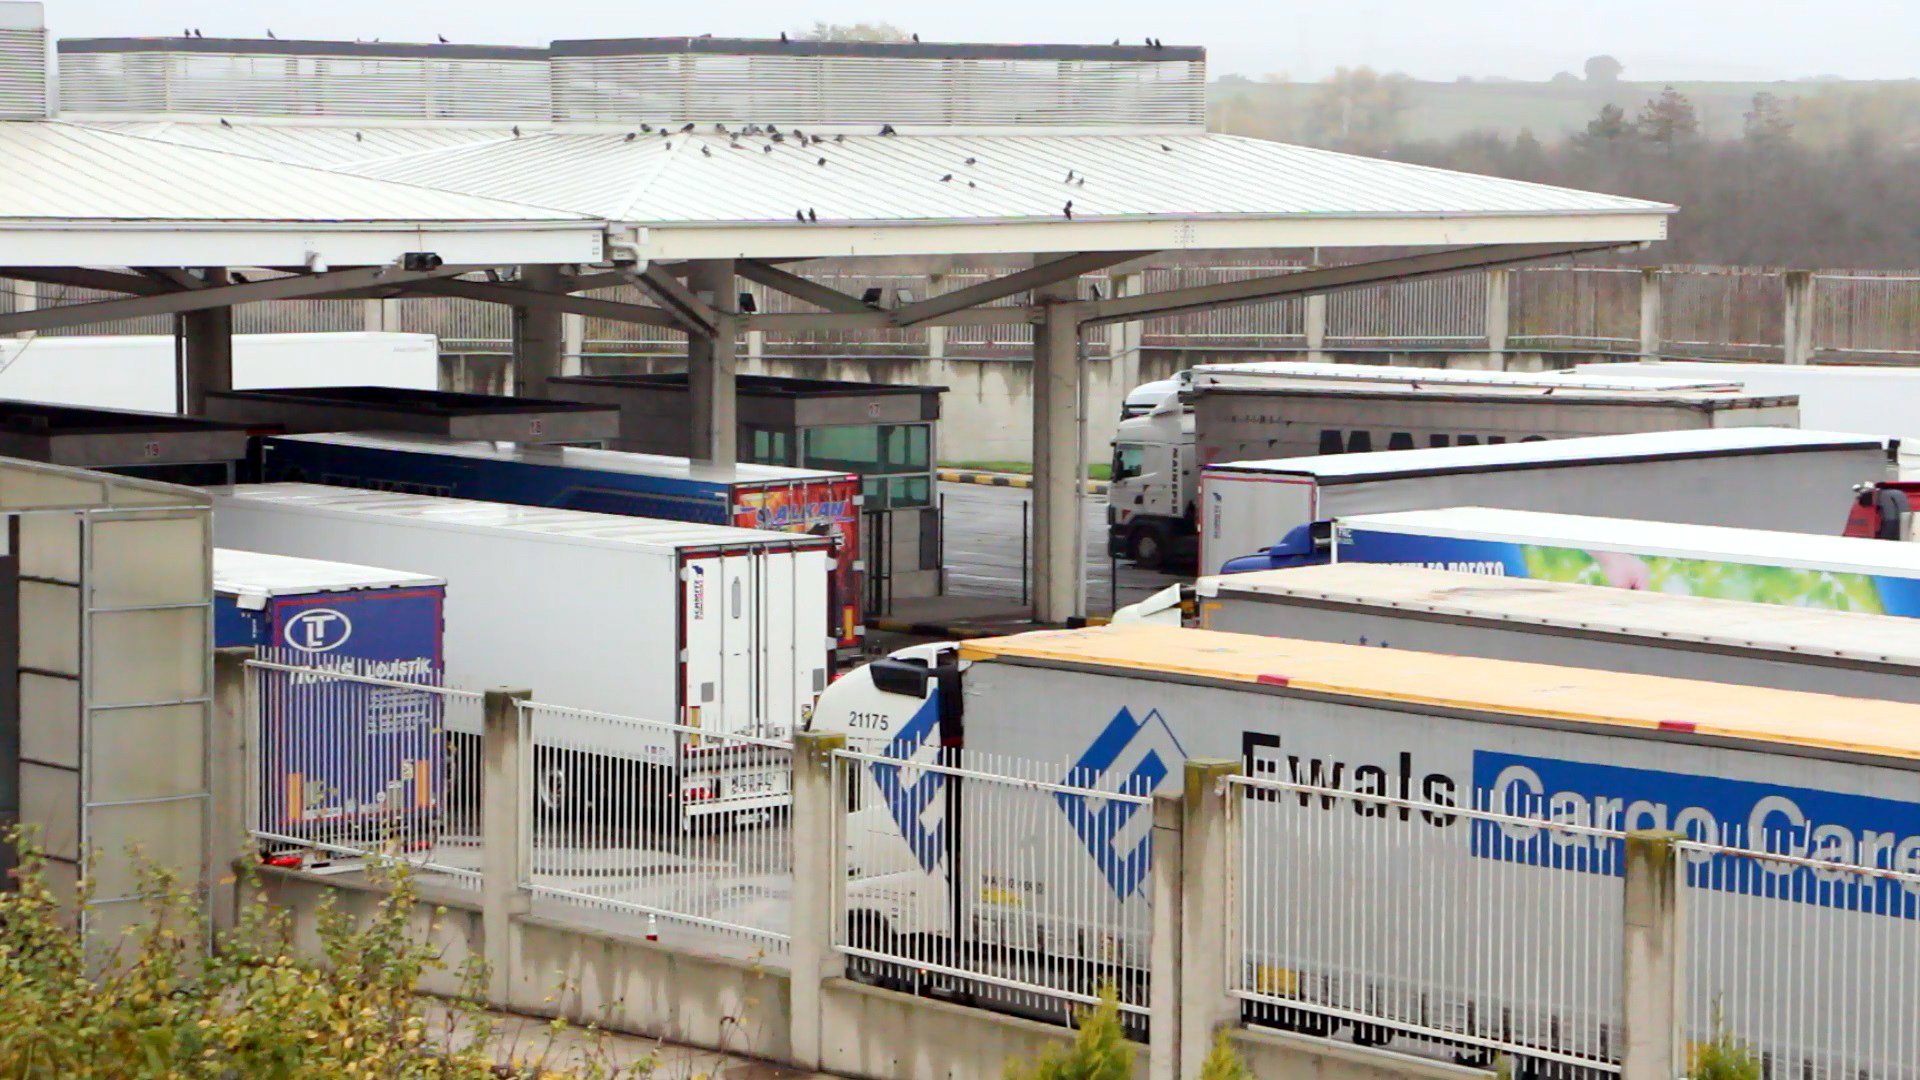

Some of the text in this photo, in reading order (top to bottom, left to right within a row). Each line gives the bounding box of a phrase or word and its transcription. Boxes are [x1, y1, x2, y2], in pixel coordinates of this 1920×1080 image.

[144, 442, 160, 456] 19
[849, 711, 889, 731] 21175
[1242, 731, 1458, 828] Ewals
[1493, 765, 1721, 864] Cargo
